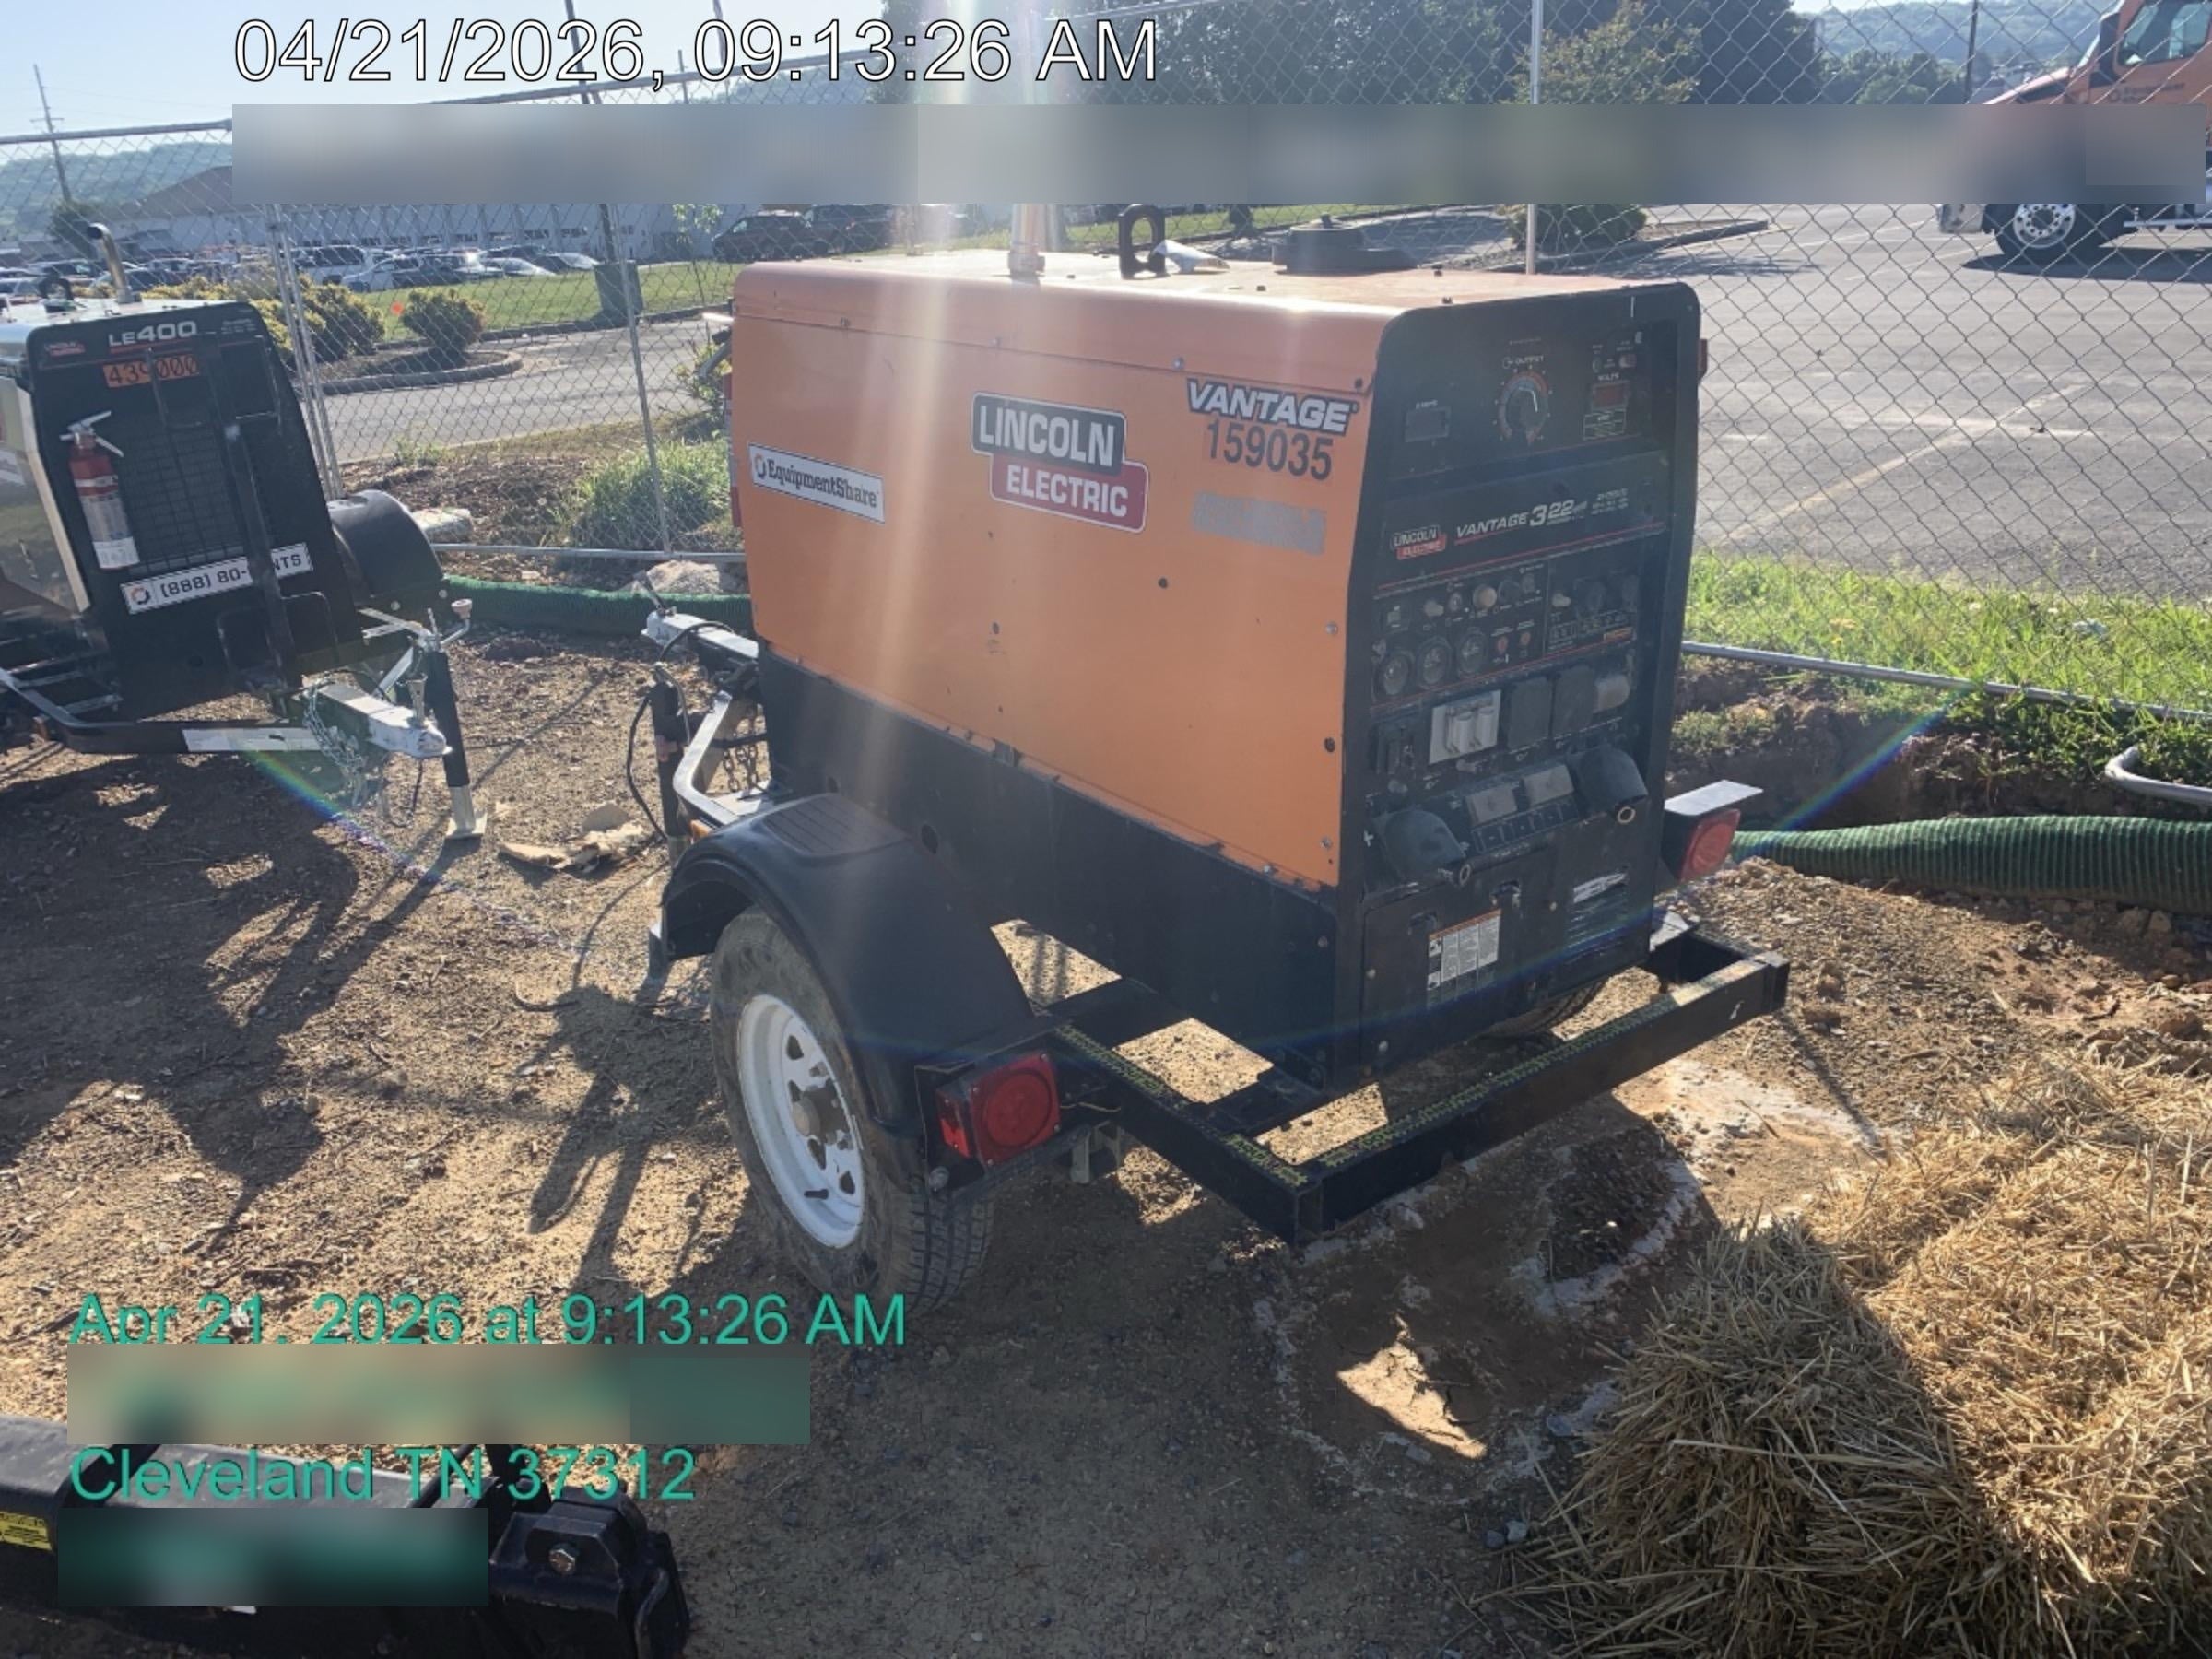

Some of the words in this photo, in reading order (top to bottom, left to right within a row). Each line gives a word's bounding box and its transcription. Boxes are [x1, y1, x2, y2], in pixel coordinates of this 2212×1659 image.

[108, 320, 197, 347] LE400
[1189, 381, 1350, 434] VANTAGE
[979, 404, 1115, 467] LINCOLN
[1206, 418, 1334, 481] 159035
[767, 458, 878, 508] EquipmentShare
[1006, 463, 1129, 518] ELECTRIC
[1393, 527, 1438, 547] LINCOLN
[1456, 512, 1527, 538] VANTAGE
[159, 573, 212, 598] (888)
